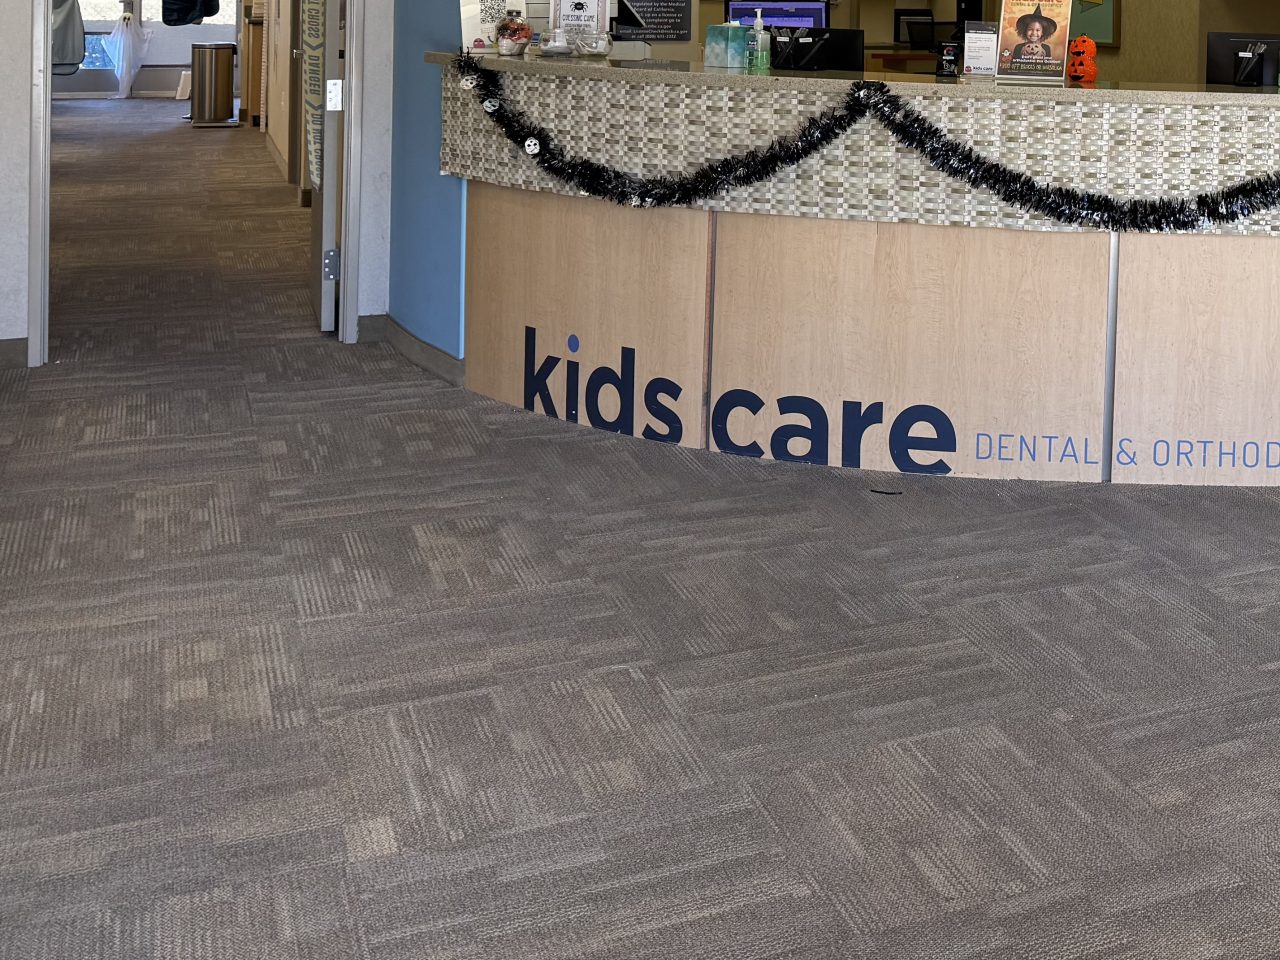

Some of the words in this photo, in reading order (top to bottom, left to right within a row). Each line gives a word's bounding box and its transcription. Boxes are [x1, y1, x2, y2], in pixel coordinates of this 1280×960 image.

[524, 326, 683, 446] kids
[711, 388, 957, 476] care
[975, 433, 1099, 465] DENTAL
[1116, 438, 1138, 466] &
